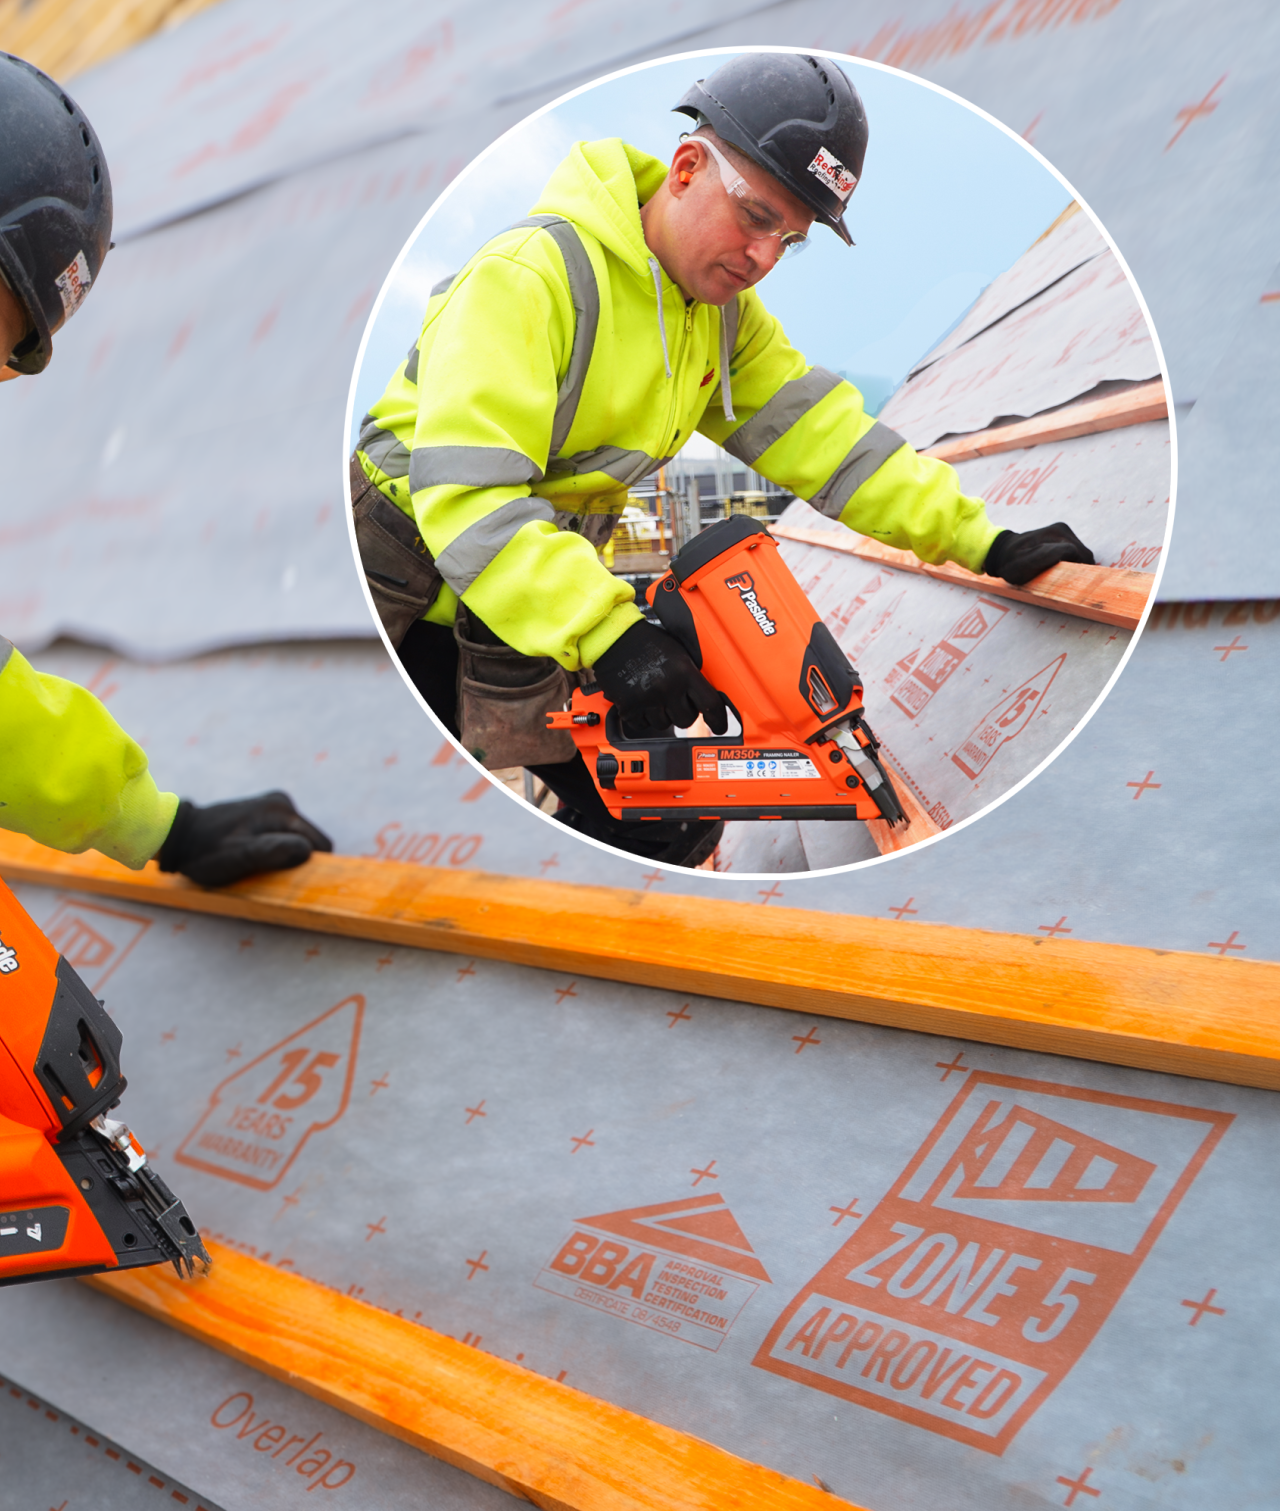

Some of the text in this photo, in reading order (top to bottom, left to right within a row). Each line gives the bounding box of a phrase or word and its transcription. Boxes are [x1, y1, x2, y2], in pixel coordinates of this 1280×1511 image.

[741, 590, 776, 636] Paslode
[994, 687, 1041, 728] 15
[720, 749, 761, 760] IM350+
[962, 740, 989, 767] WARRANTY
[977, 724, 1002, 748] YEARS
[256, 1047, 342, 1112] 15
[225, 1104, 295, 1141] YEARS
[196, 1130, 285, 1171] WARRANTY
[549, 1230, 657, 1300] BBA
[657, 1269, 728, 1301] INSPECTION
[664, 1259, 725, 1287] APPROVAL
[846, 1221, 1096, 1344] ZONE 5
[573, 1286, 682, 1333] CERTIFICATE 08/4548
[644, 1291, 729, 1329] CERTIFICATION
[651, 1280, 700, 1306] TESTING
[785, 1305, 1023, 1422] APPROVED
[210, 1391, 357, 1493] Overlap
